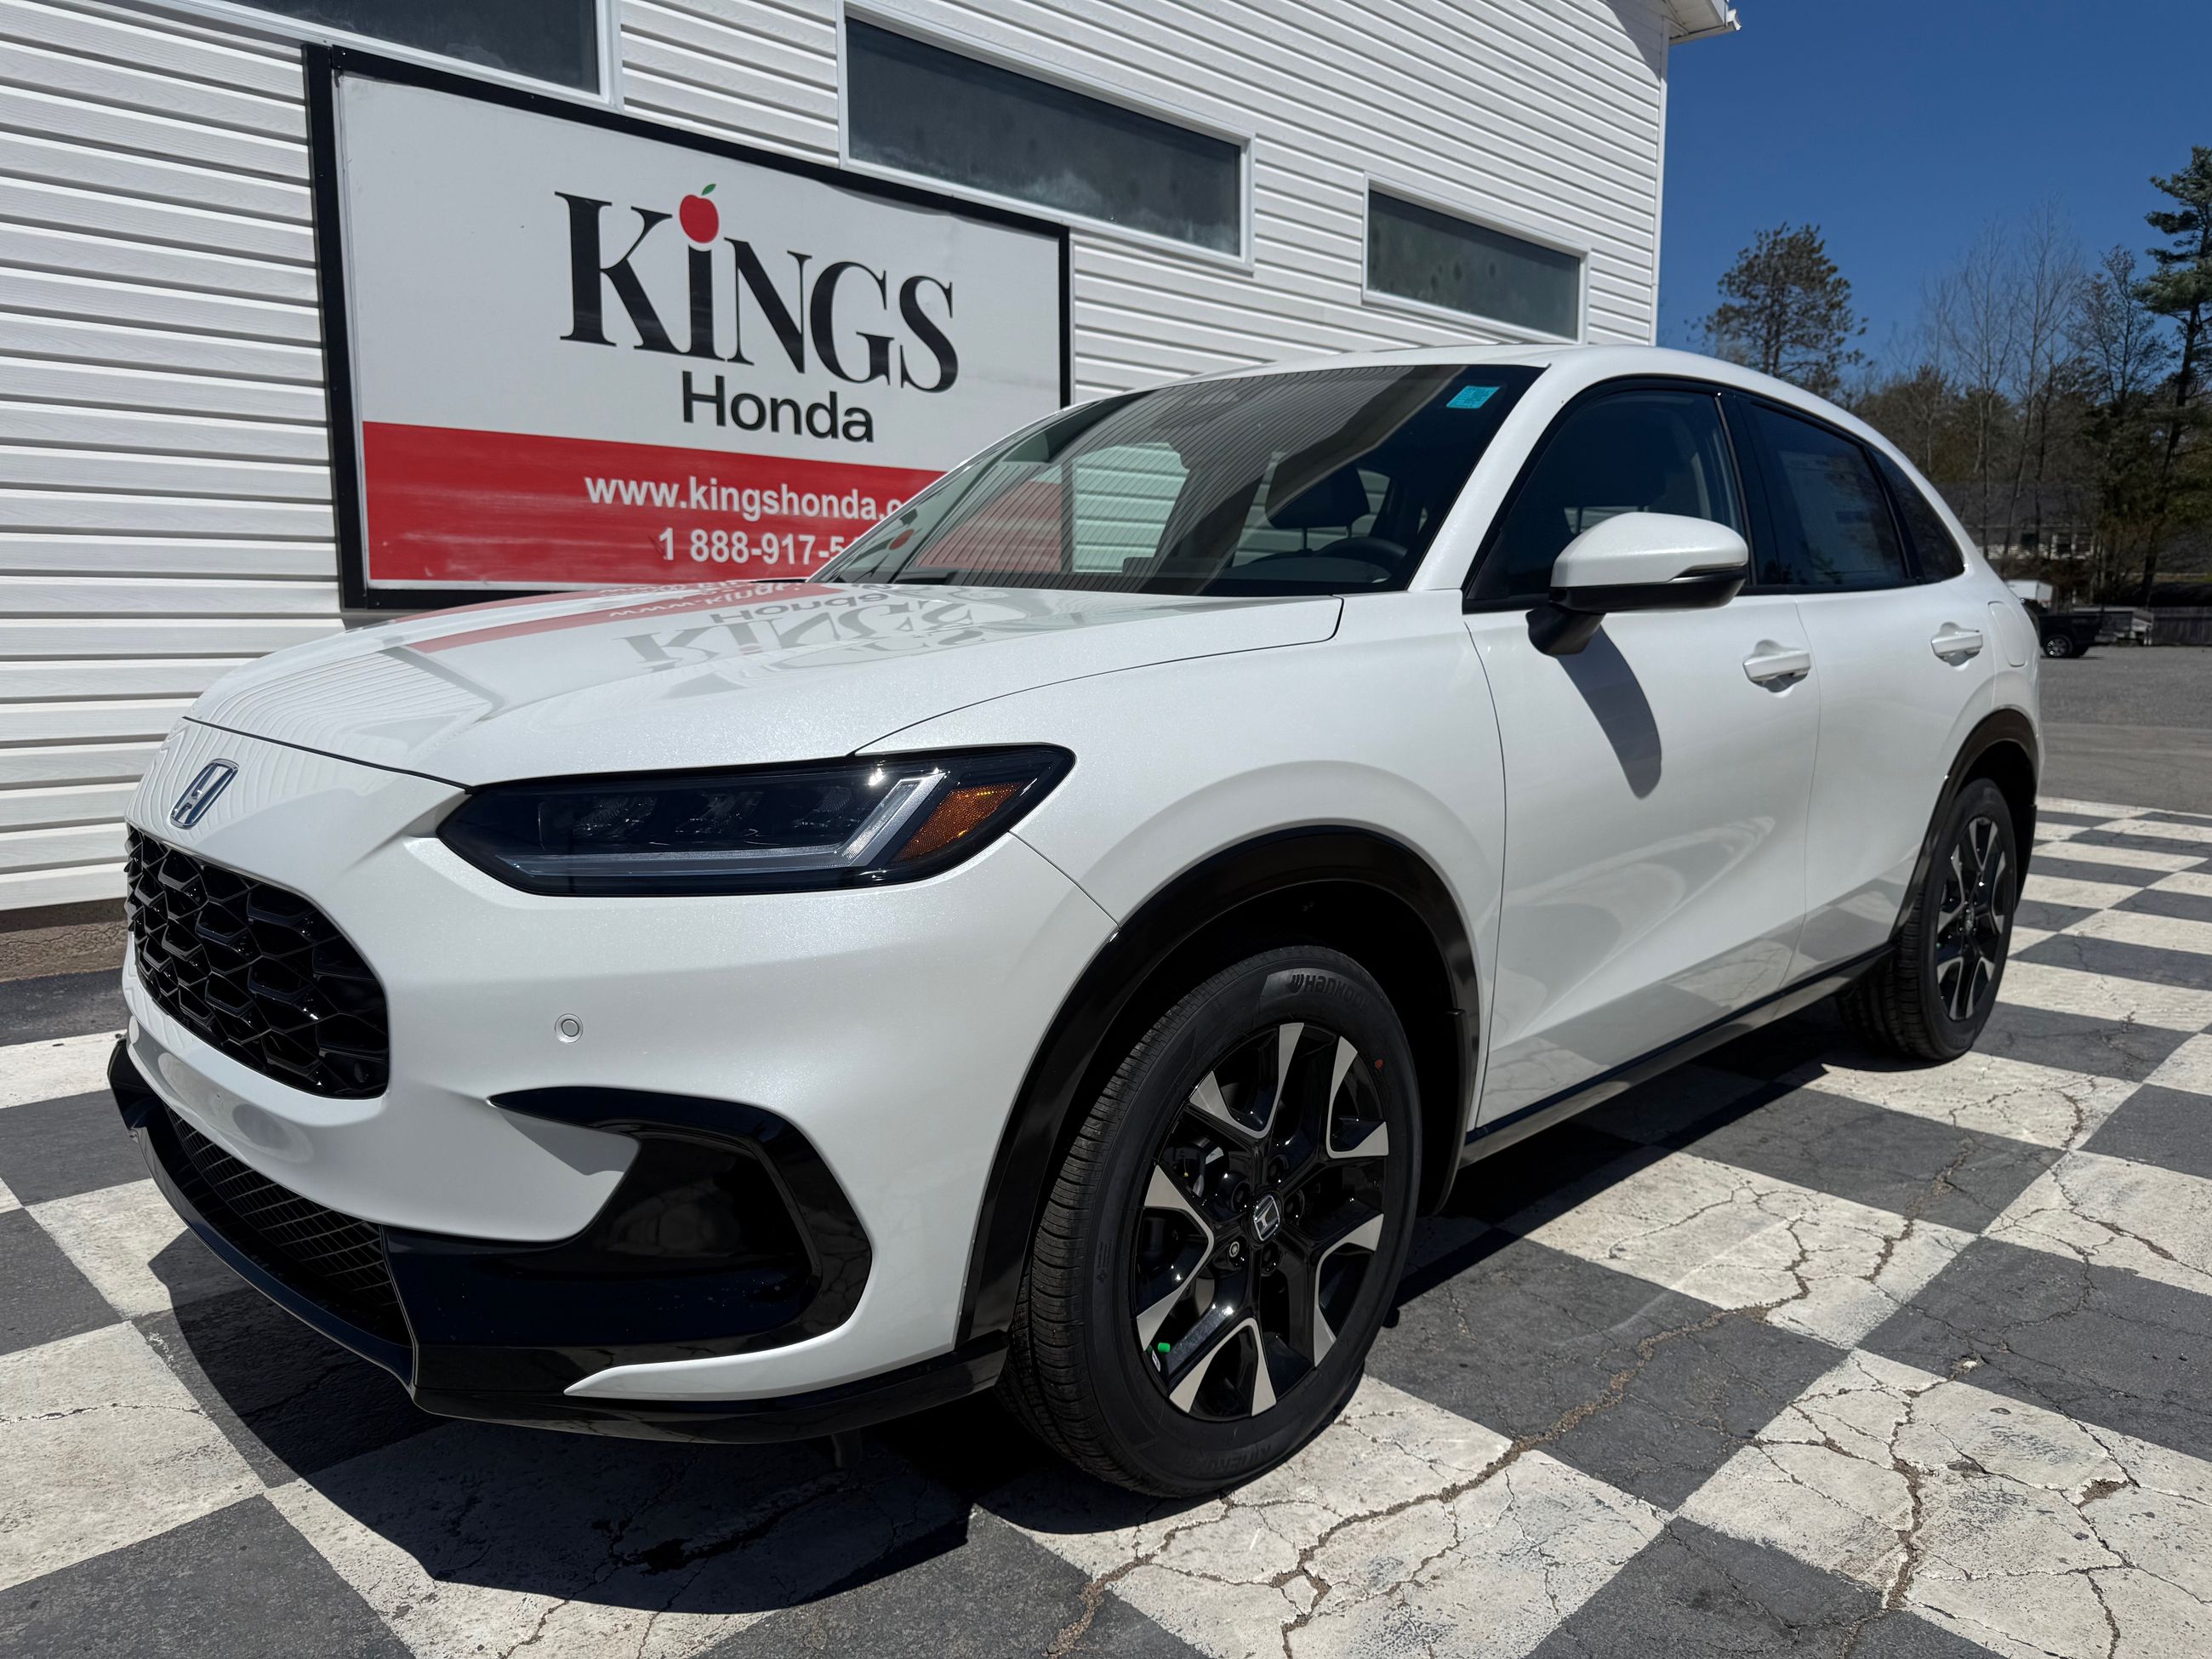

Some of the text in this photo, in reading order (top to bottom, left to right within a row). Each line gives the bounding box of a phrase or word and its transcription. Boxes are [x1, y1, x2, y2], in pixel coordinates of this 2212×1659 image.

[681, 370, 875, 443] Honda
[658, 527, 858, 566] 1 888-917-5
